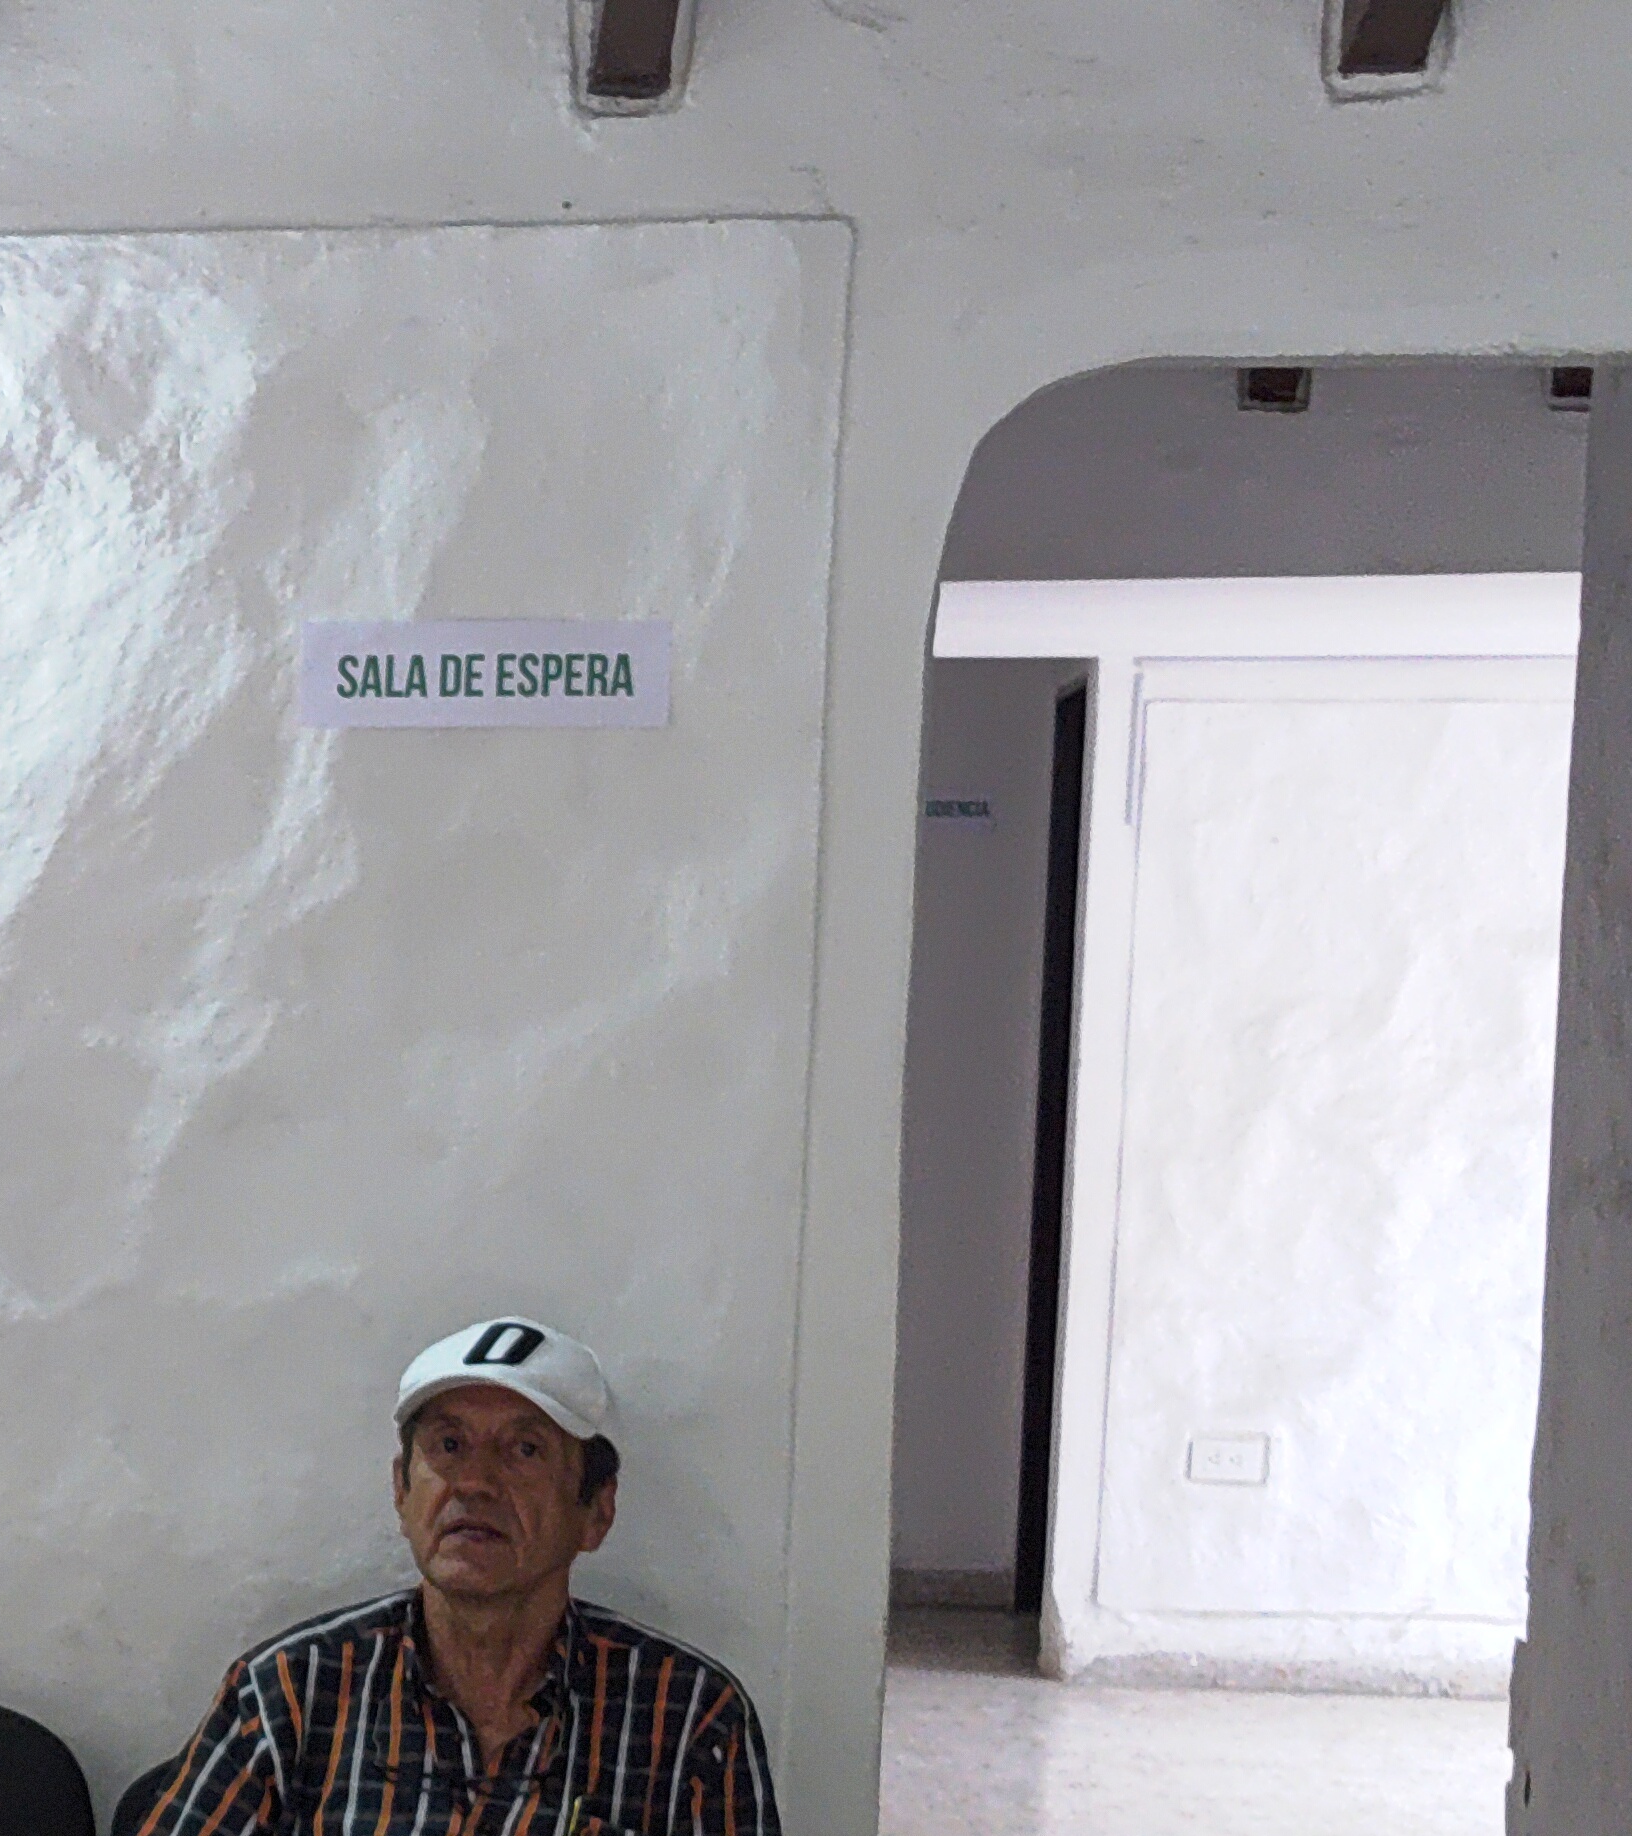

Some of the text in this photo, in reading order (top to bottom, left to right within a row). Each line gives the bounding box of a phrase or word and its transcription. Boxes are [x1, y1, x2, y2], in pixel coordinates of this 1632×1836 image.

[336, 653, 635, 699] SALA DE ESPERA
